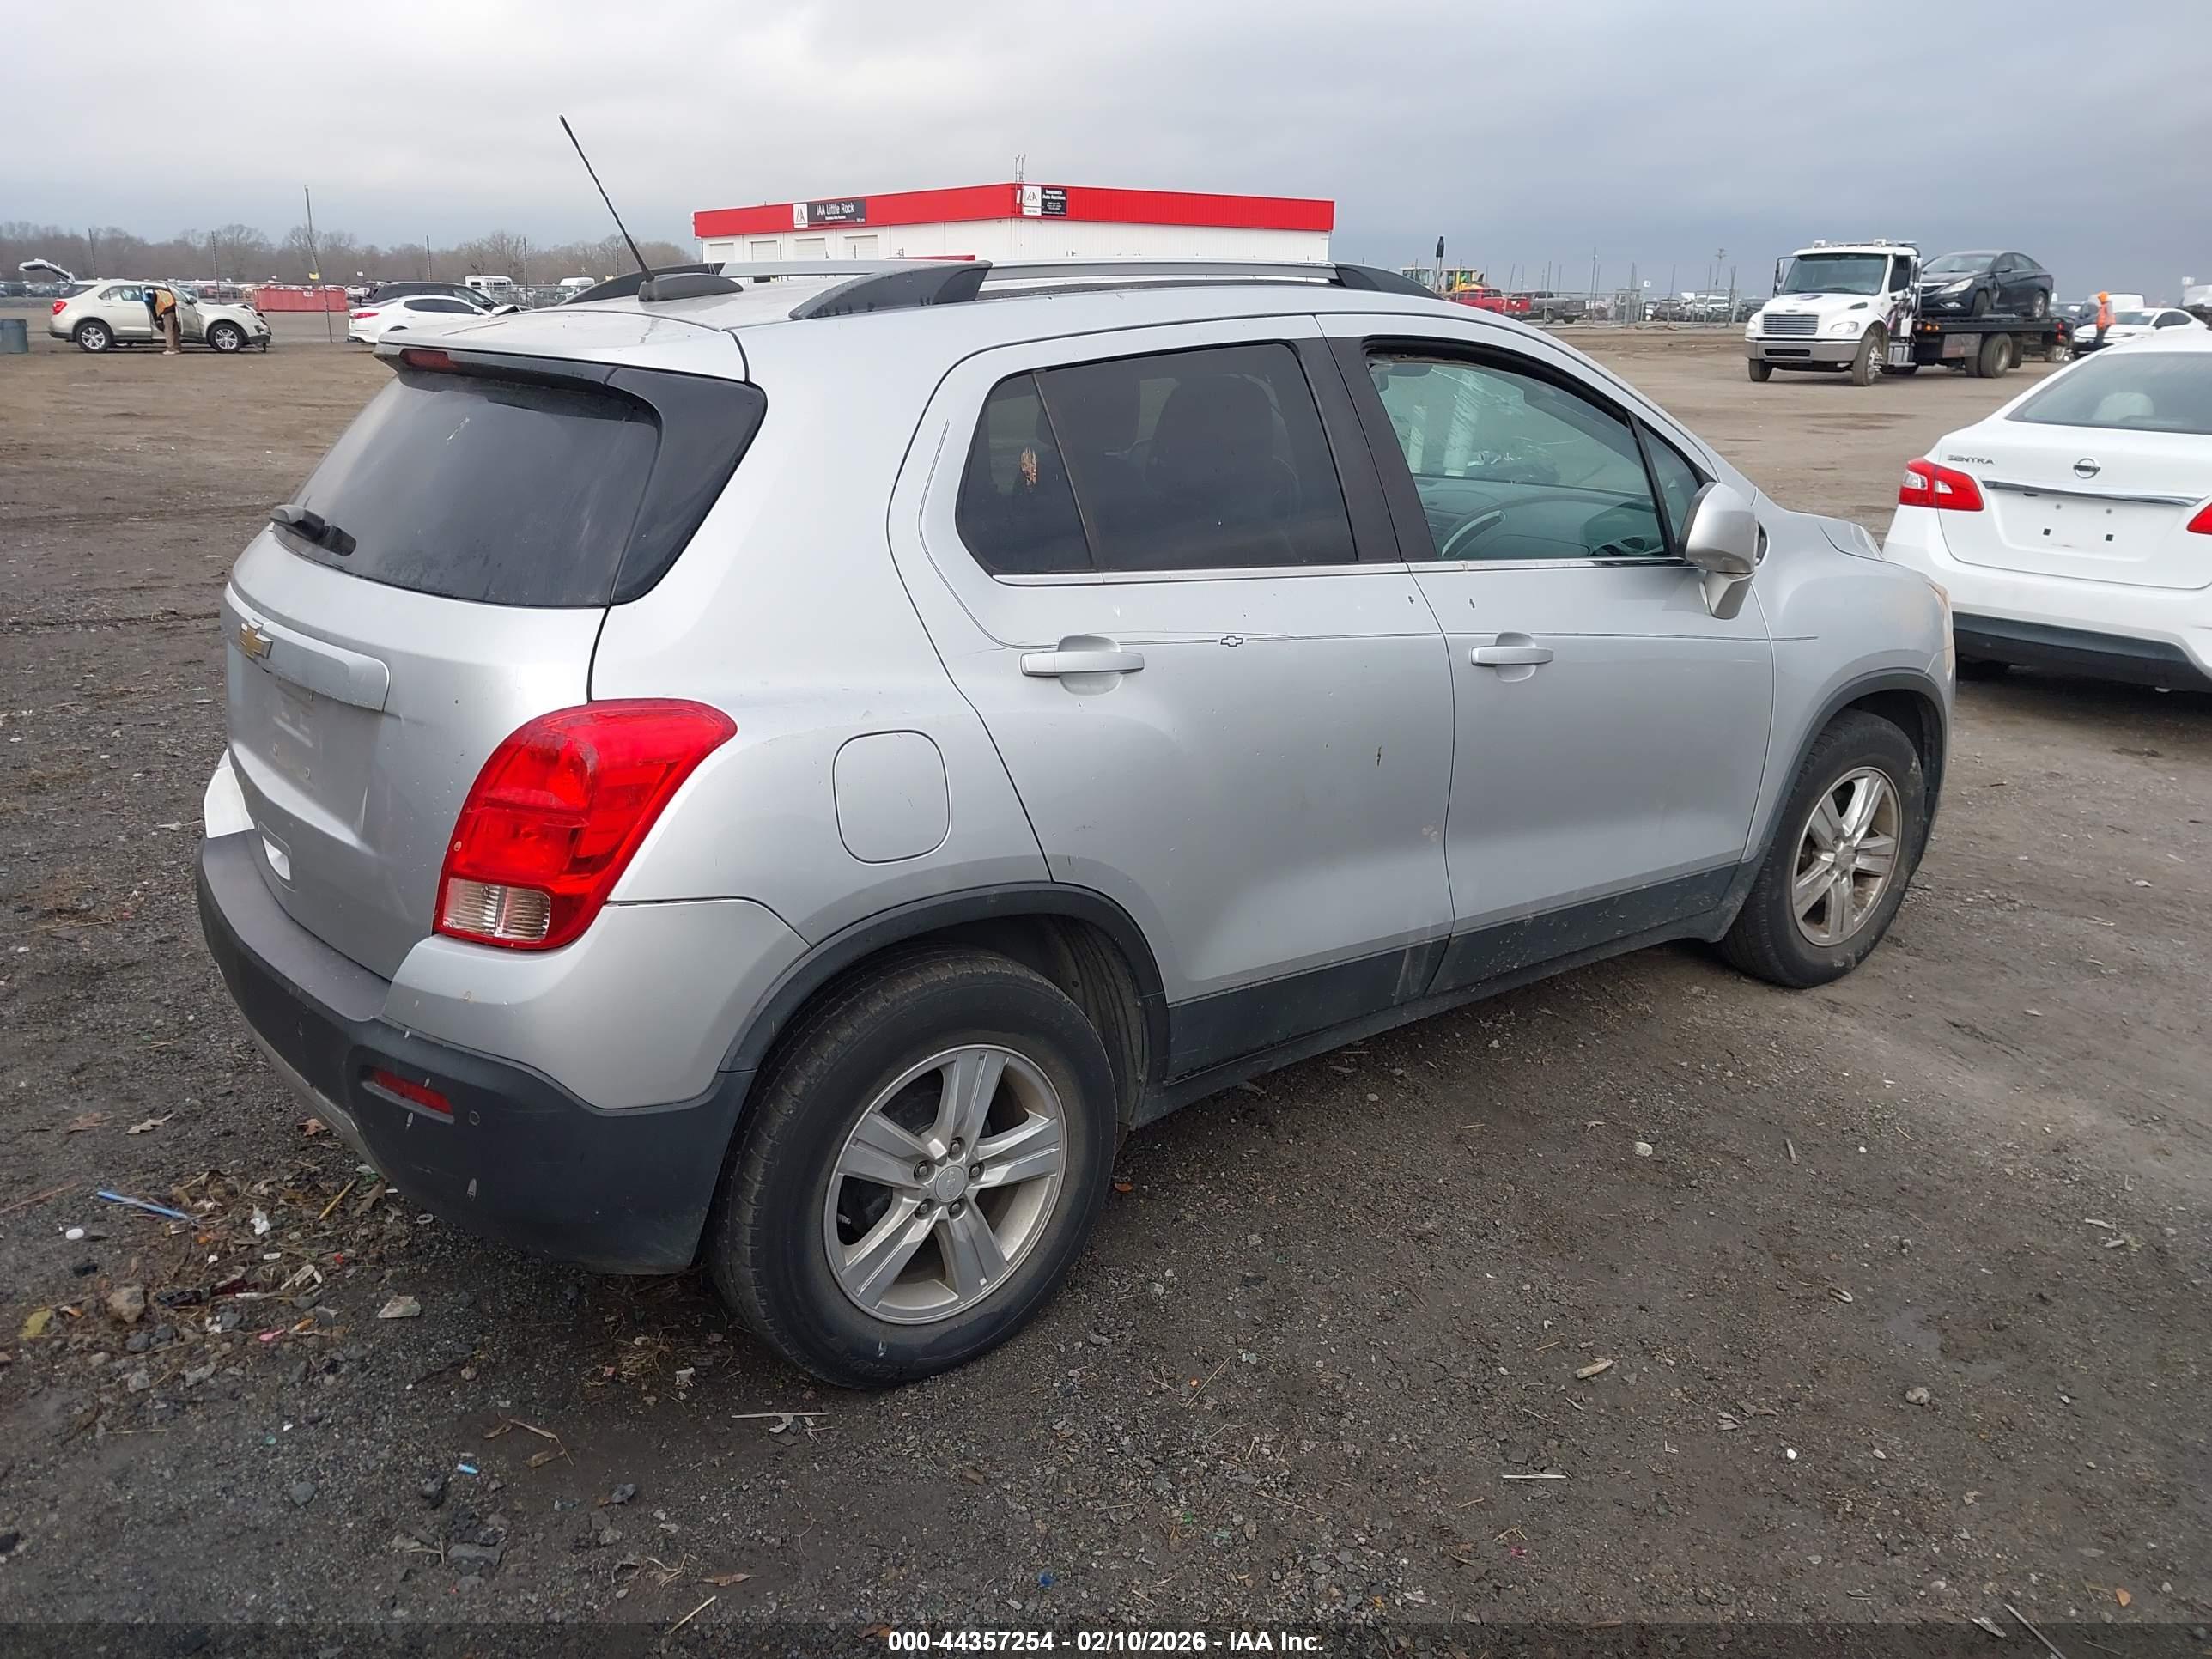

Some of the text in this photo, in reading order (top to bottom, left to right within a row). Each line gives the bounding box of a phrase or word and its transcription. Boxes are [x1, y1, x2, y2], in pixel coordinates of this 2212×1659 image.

[816, 202, 855, 216] IAA Little Rock
[1947, 454, 1996, 465] SENTRA
